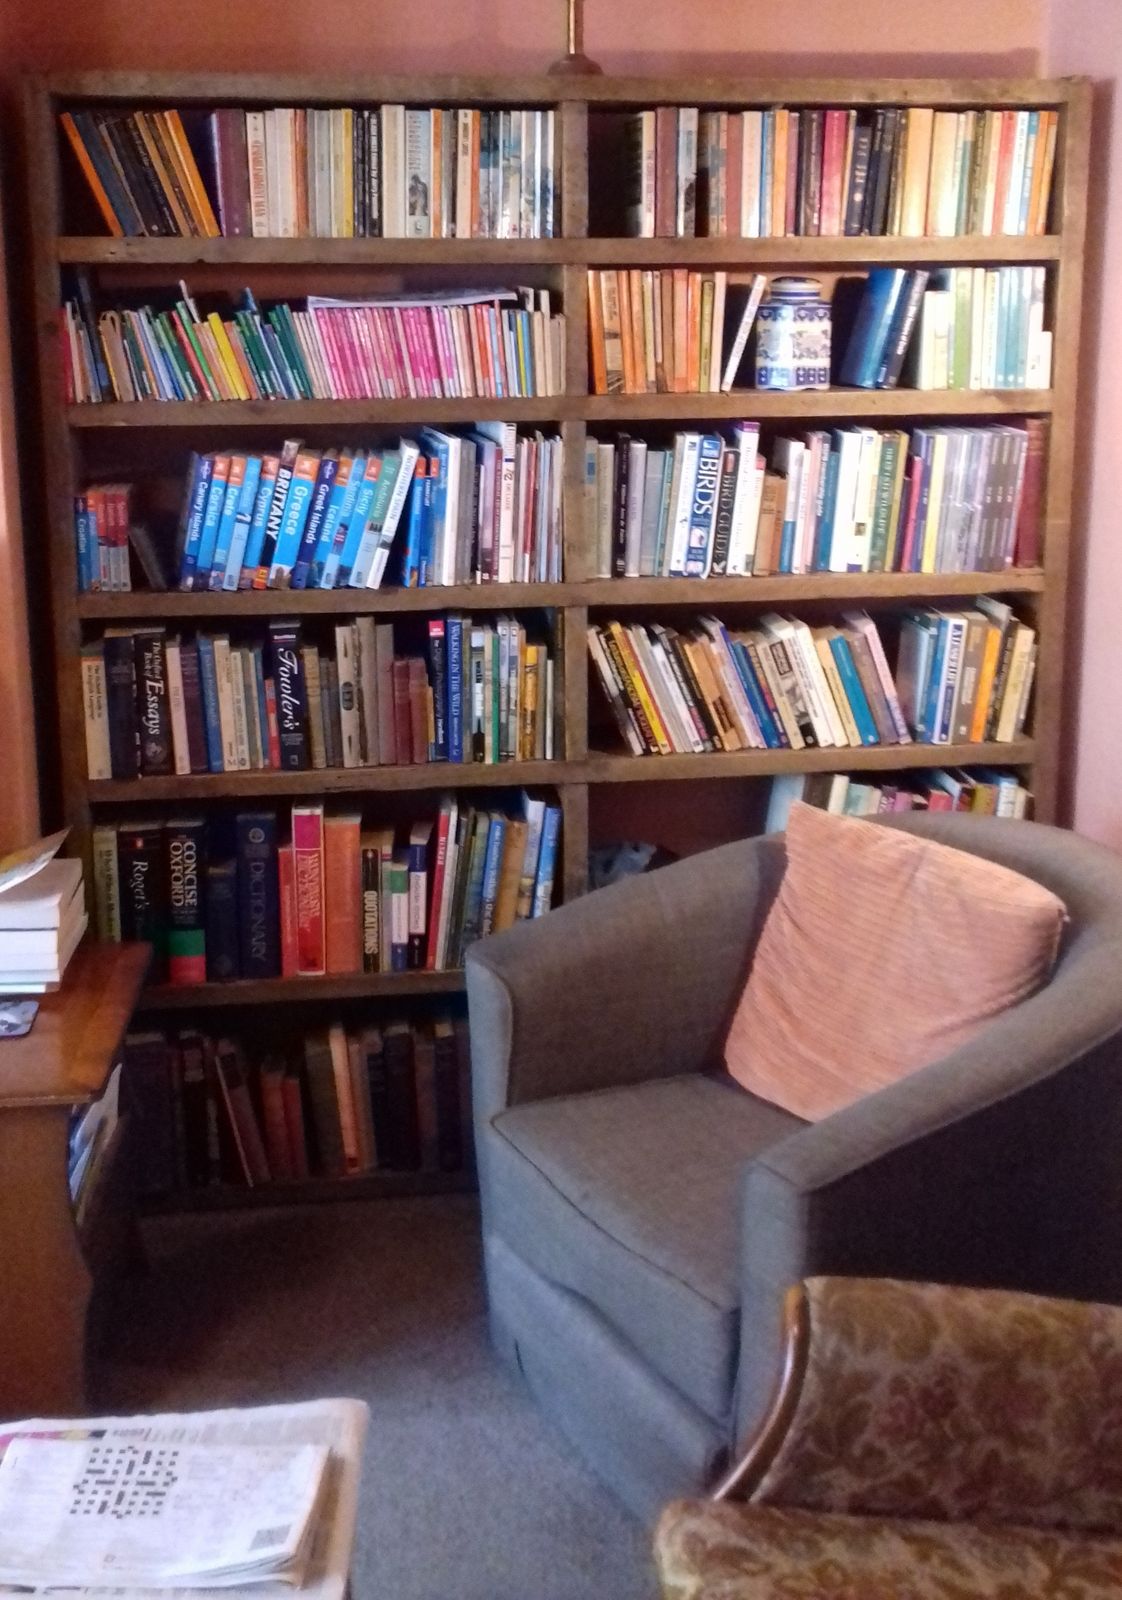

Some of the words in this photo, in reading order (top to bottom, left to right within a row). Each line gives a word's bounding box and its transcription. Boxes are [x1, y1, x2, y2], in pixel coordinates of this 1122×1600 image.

[395, 455, 413, 497] NORTHERN
[693, 457, 718, 515] BIRDS
[720, 475, 734, 509] BIRD
[192, 481, 208, 511] Canary
[205, 487, 221, 527] Corsica
[225, 487, 237, 516] Crete
[255, 487, 270, 527] Cyprus
[267, 468, 291, 540] BRITTANY
[285, 486, 308, 535] Greece
[314, 484, 329, 511] Greek
[357, 489, 373, 515] Sicily
[191, 512, 202, 541] Islands
[305, 513, 322, 545] Islands
[321, 504, 339, 542] Iceland
[715, 512, 731, 557] GUIDE
[143, 652, 153, 667] Book
[153, 642, 161, 654] The
[450, 625, 460, 662] WALKING
[144, 668, 153, 678] of
[153, 655, 162, 679] Oxford
[451, 663, 460, 673] IN
[451, 676, 461, 692] THE
[142, 680, 164, 734] Essays
[278, 648, 299, 730] Fowler's
[451, 694, 461, 715] WILD
[130, 861, 149, 910] Roget's
[169, 842, 184, 907] OXFORD
[183, 841, 197, 907] CONCISE
[250, 862, 266, 962] DICTIONARY
[364, 890, 378, 954] QUOTATIONS
